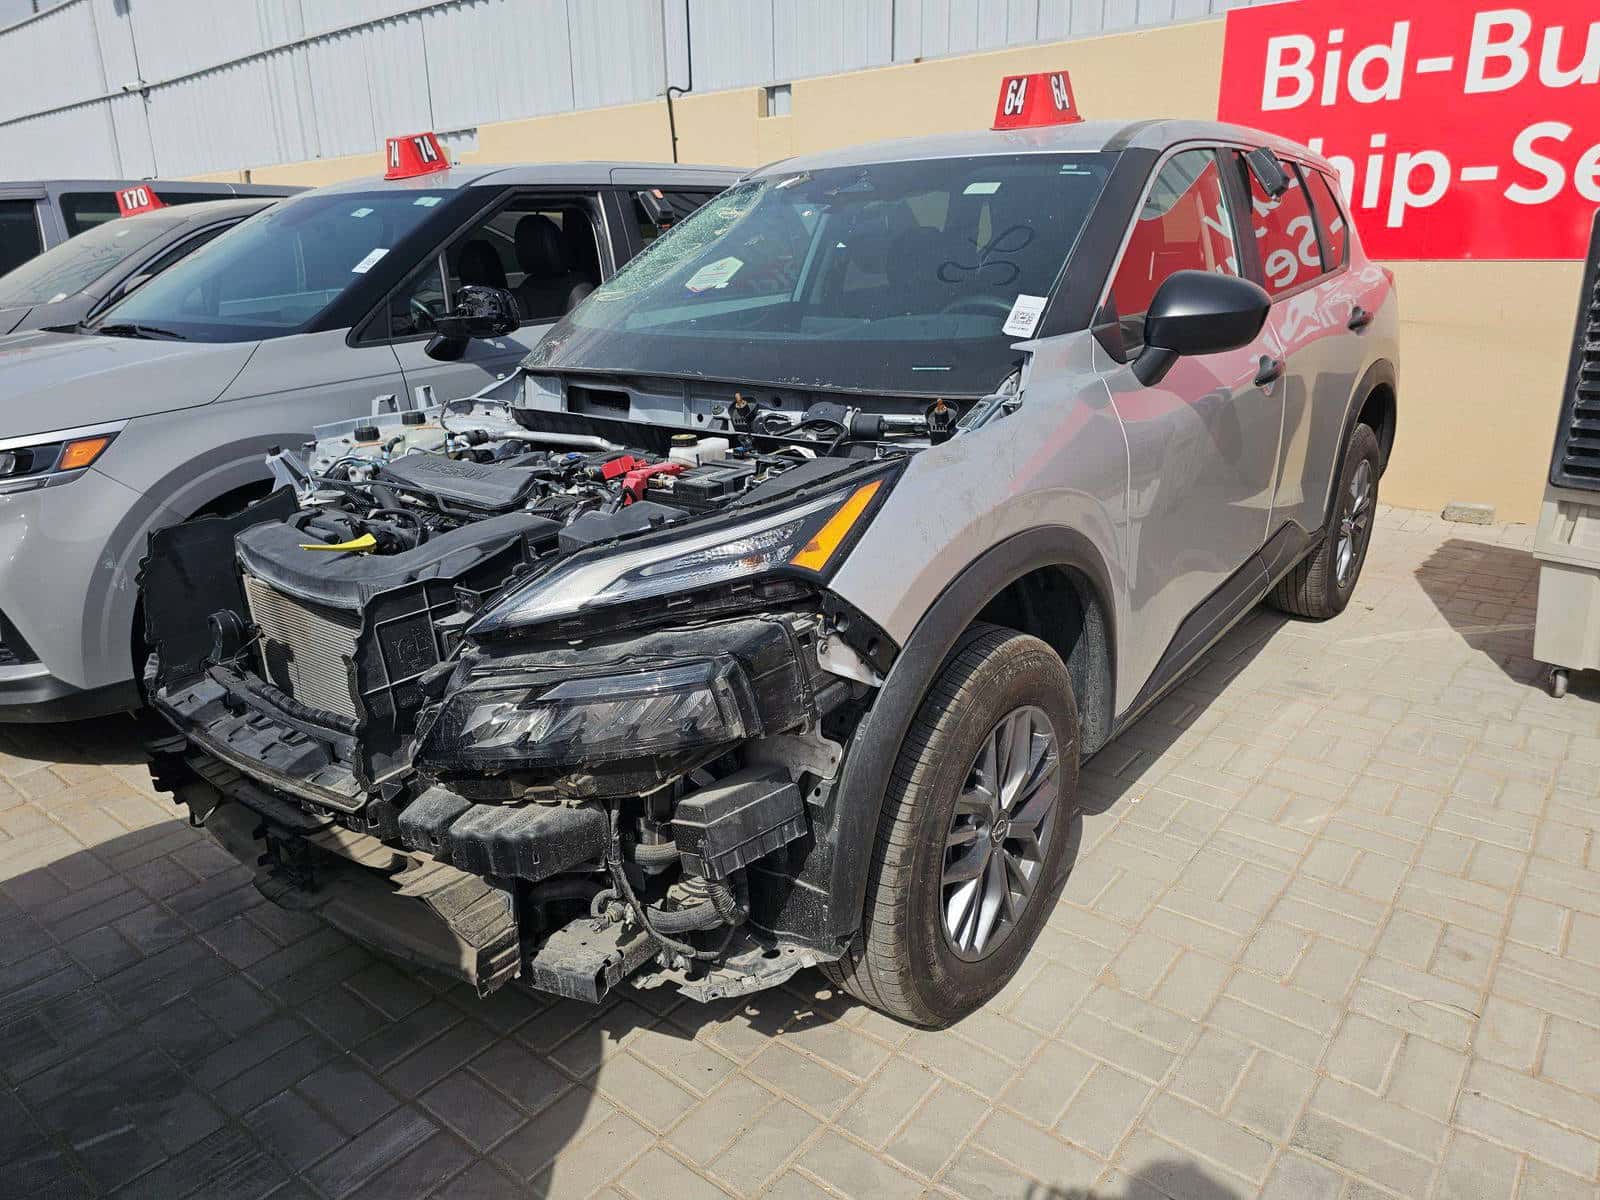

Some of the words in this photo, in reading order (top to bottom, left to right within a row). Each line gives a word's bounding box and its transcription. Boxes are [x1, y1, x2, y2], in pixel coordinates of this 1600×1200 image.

[1004, 77, 1027, 115] 64
[1051, 73, 1070, 110] 64
[414, 135, 438, 163] 74
[1305, 121, 1600, 228] hip-Se
[122, 188, 149, 210] 170
